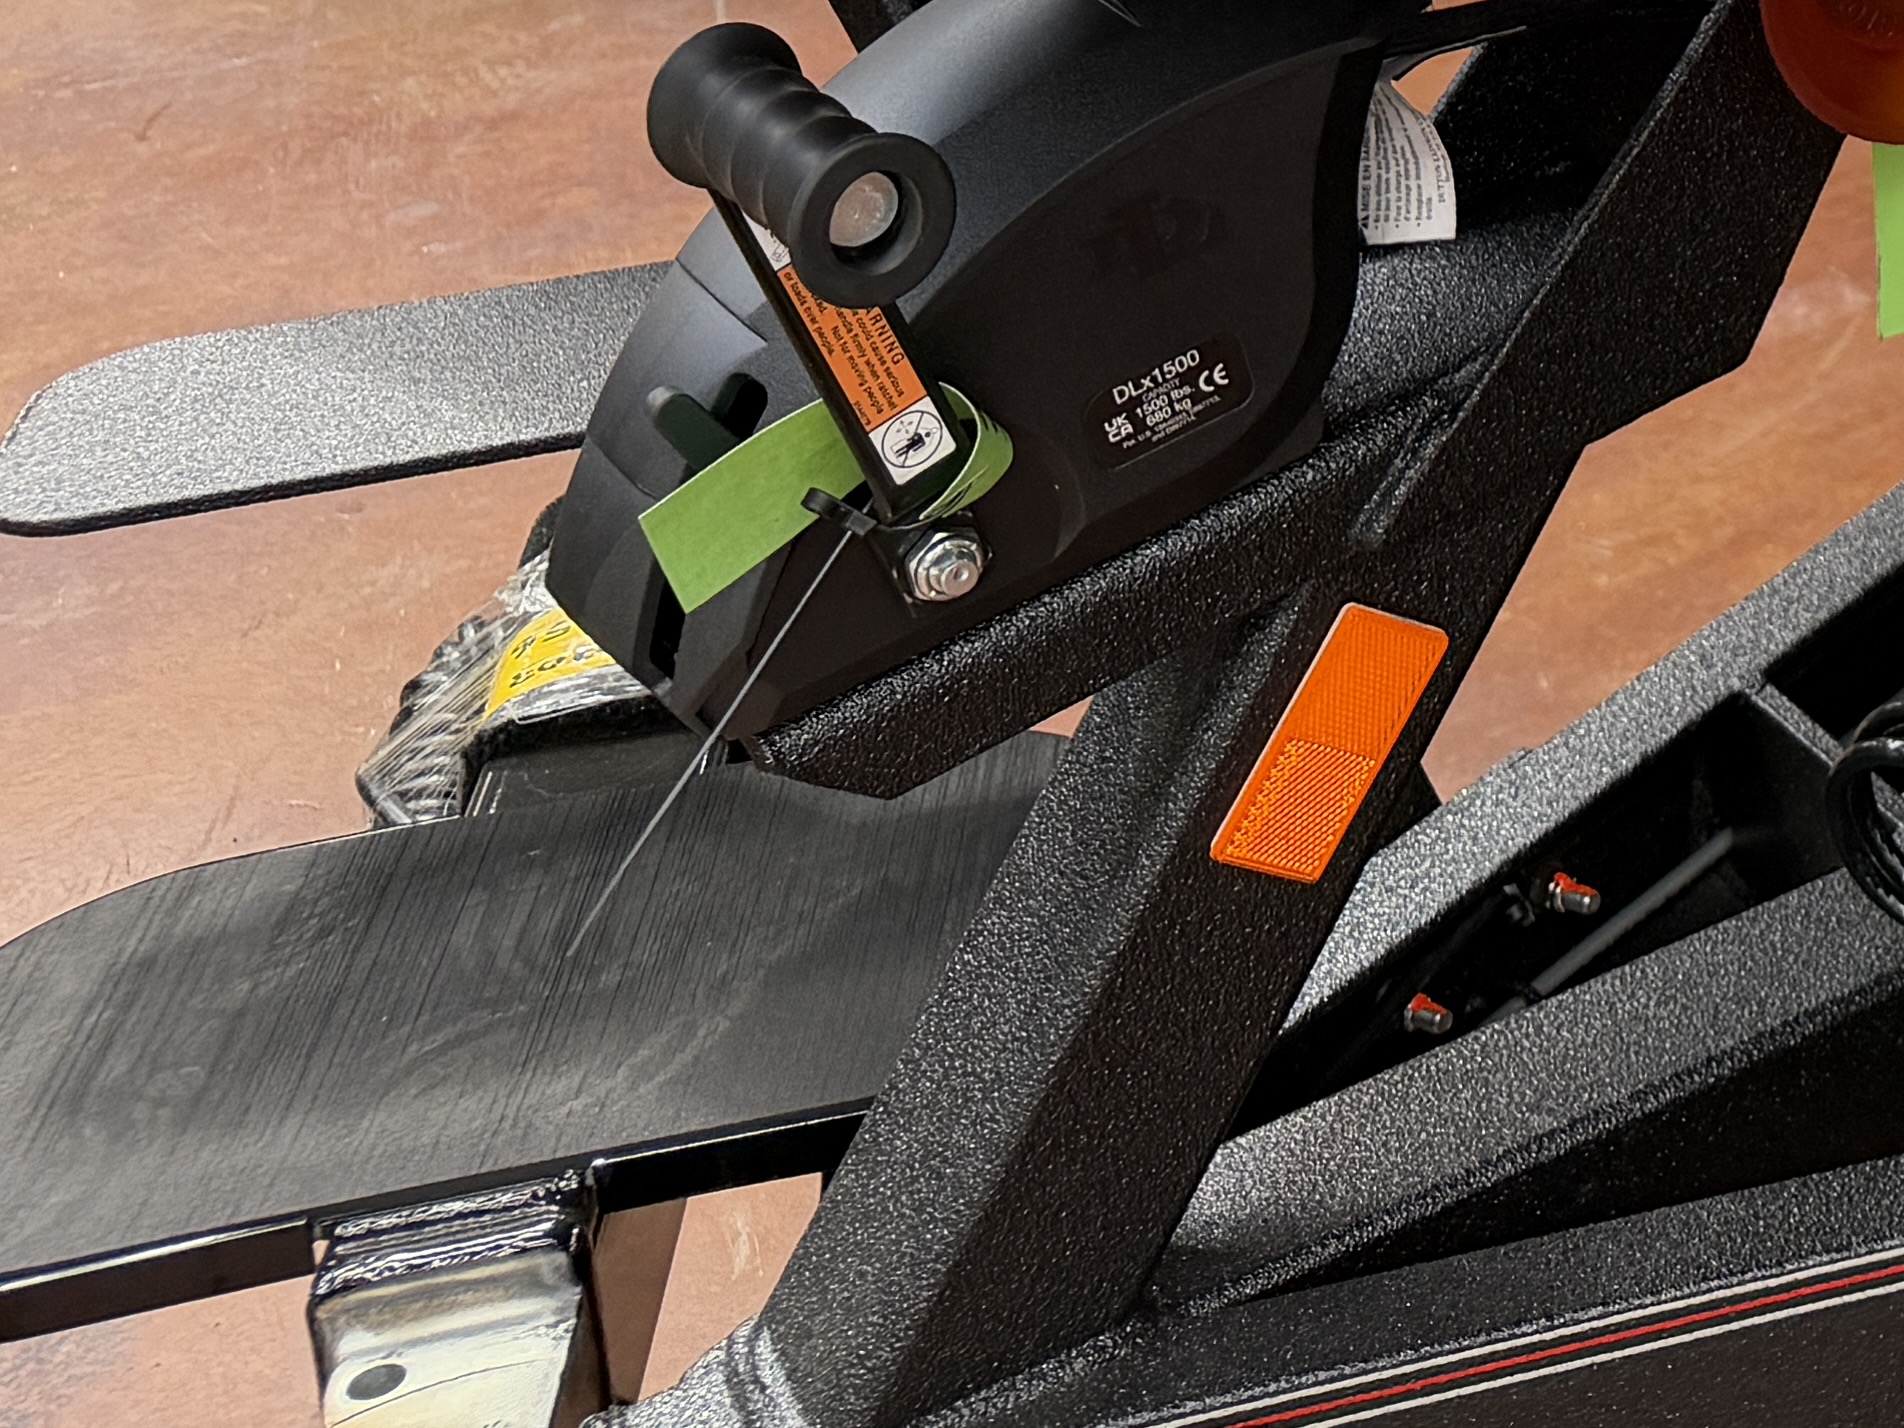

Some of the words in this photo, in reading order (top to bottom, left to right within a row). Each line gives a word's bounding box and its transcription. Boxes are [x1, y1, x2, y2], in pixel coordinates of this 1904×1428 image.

[865, 307, 905, 366] RNING
[1112, 349, 1200, 405] DLx1500
[1142, 377, 1180, 403] CAPACITY
[1135, 396, 1169, 419] 1500
[1170, 385, 1195, 401] lbs.
[1146, 407, 1171, 427] 680
[1174, 398, 1192, 413] kg
[1104, 412, 1129, 433] UK
